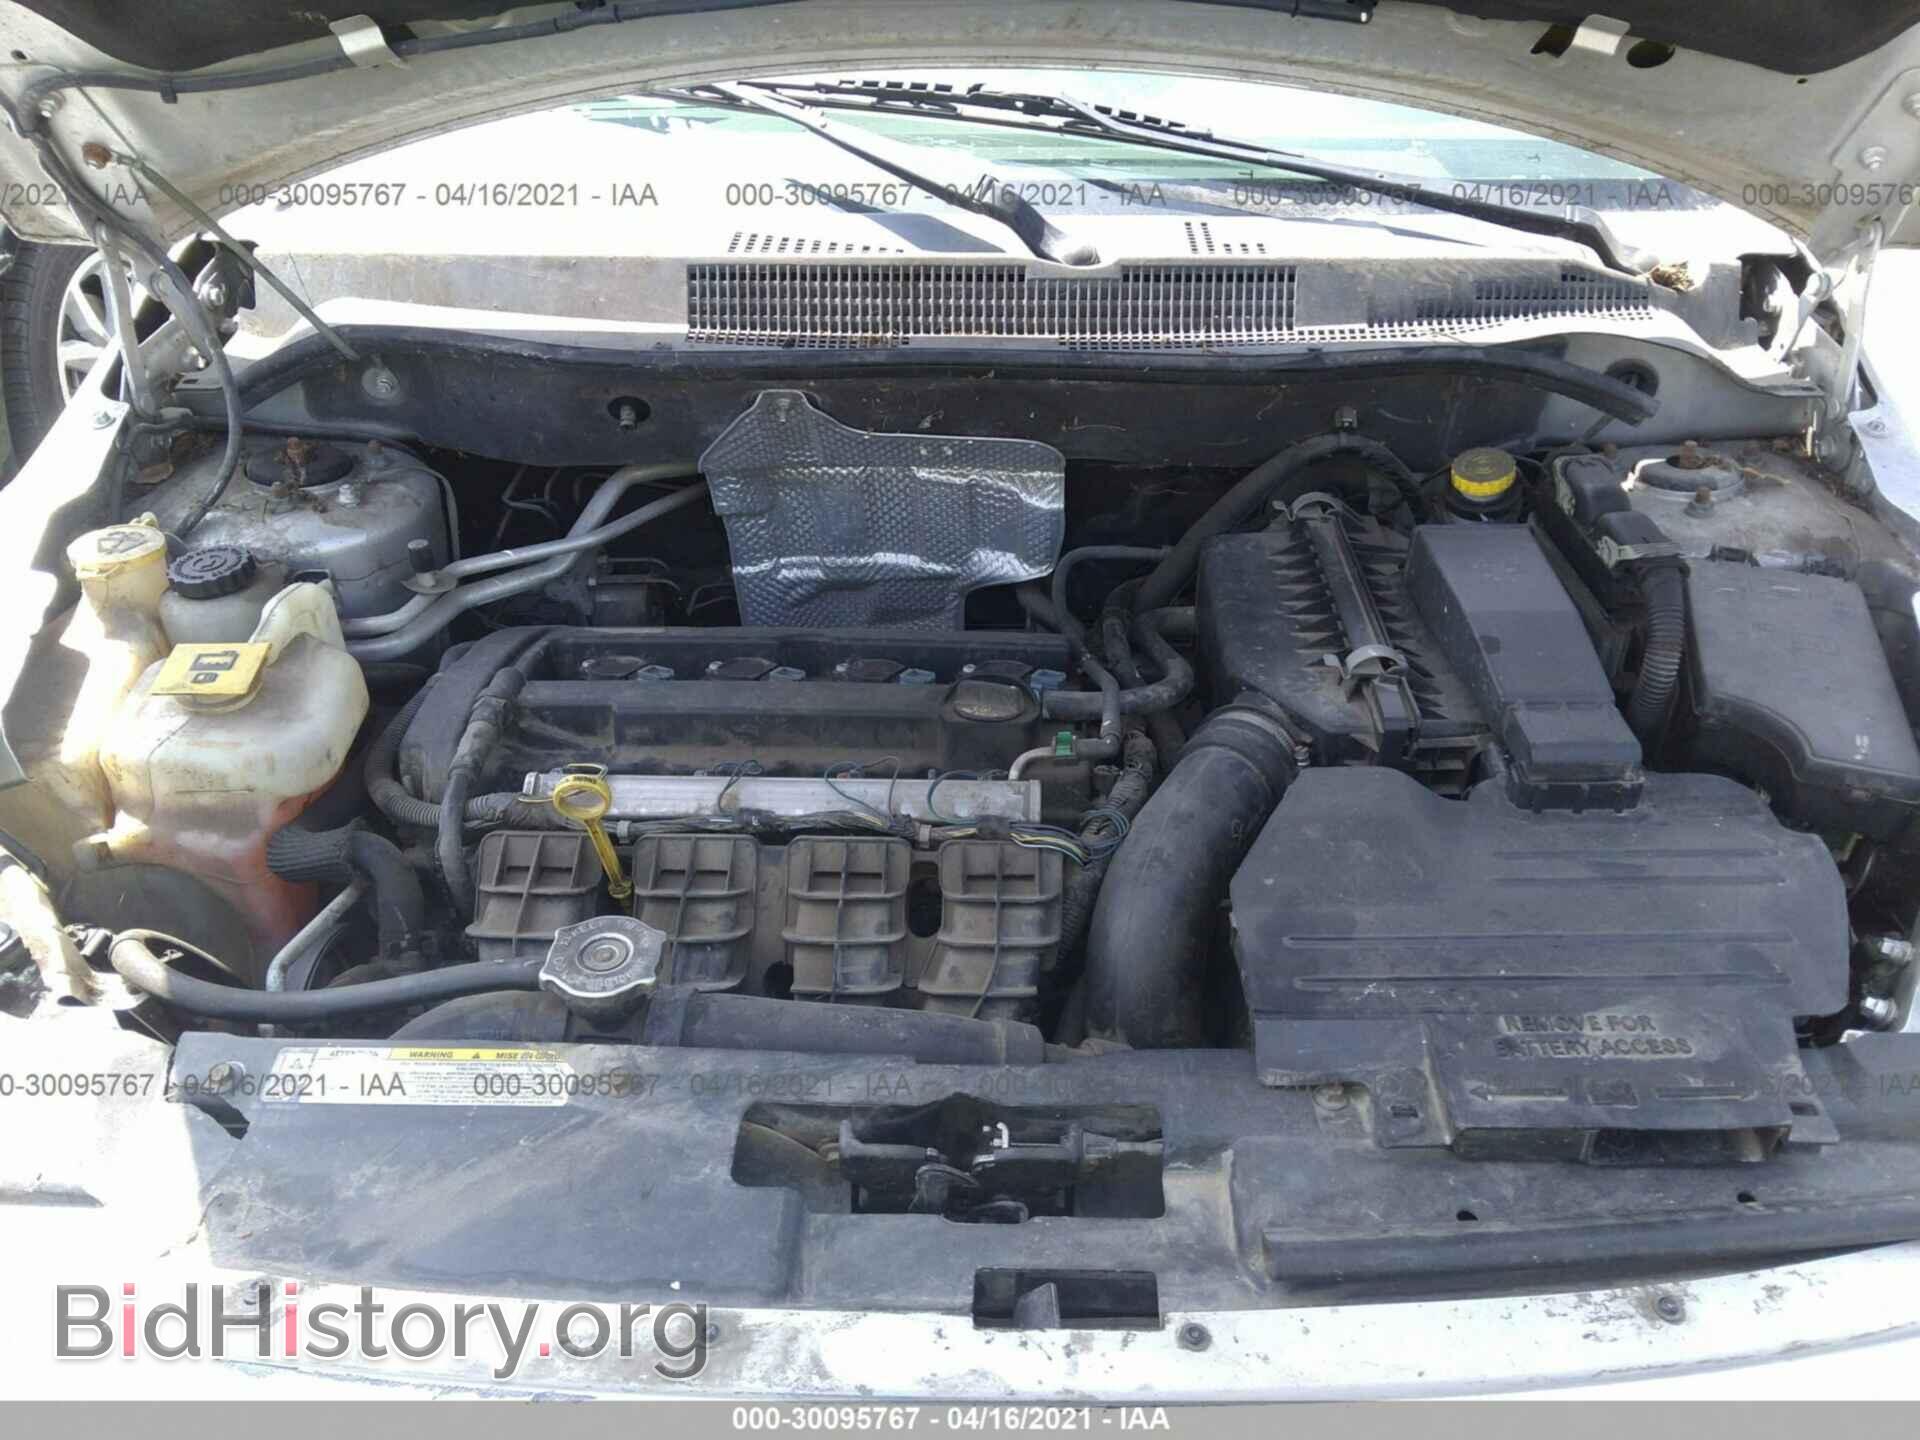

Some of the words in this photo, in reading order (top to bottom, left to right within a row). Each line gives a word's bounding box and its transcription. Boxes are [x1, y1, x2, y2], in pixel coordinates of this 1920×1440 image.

[1503, 1014, 1602, 1032] REMOVE
[1605, 1014, 1656, 1032] FOR
[409, 1051, 453, 1059] WARNING
[1496, 1038, 1591, 1057] BATTERY
[1600, 1037, 1693, 1055] ACCESS
